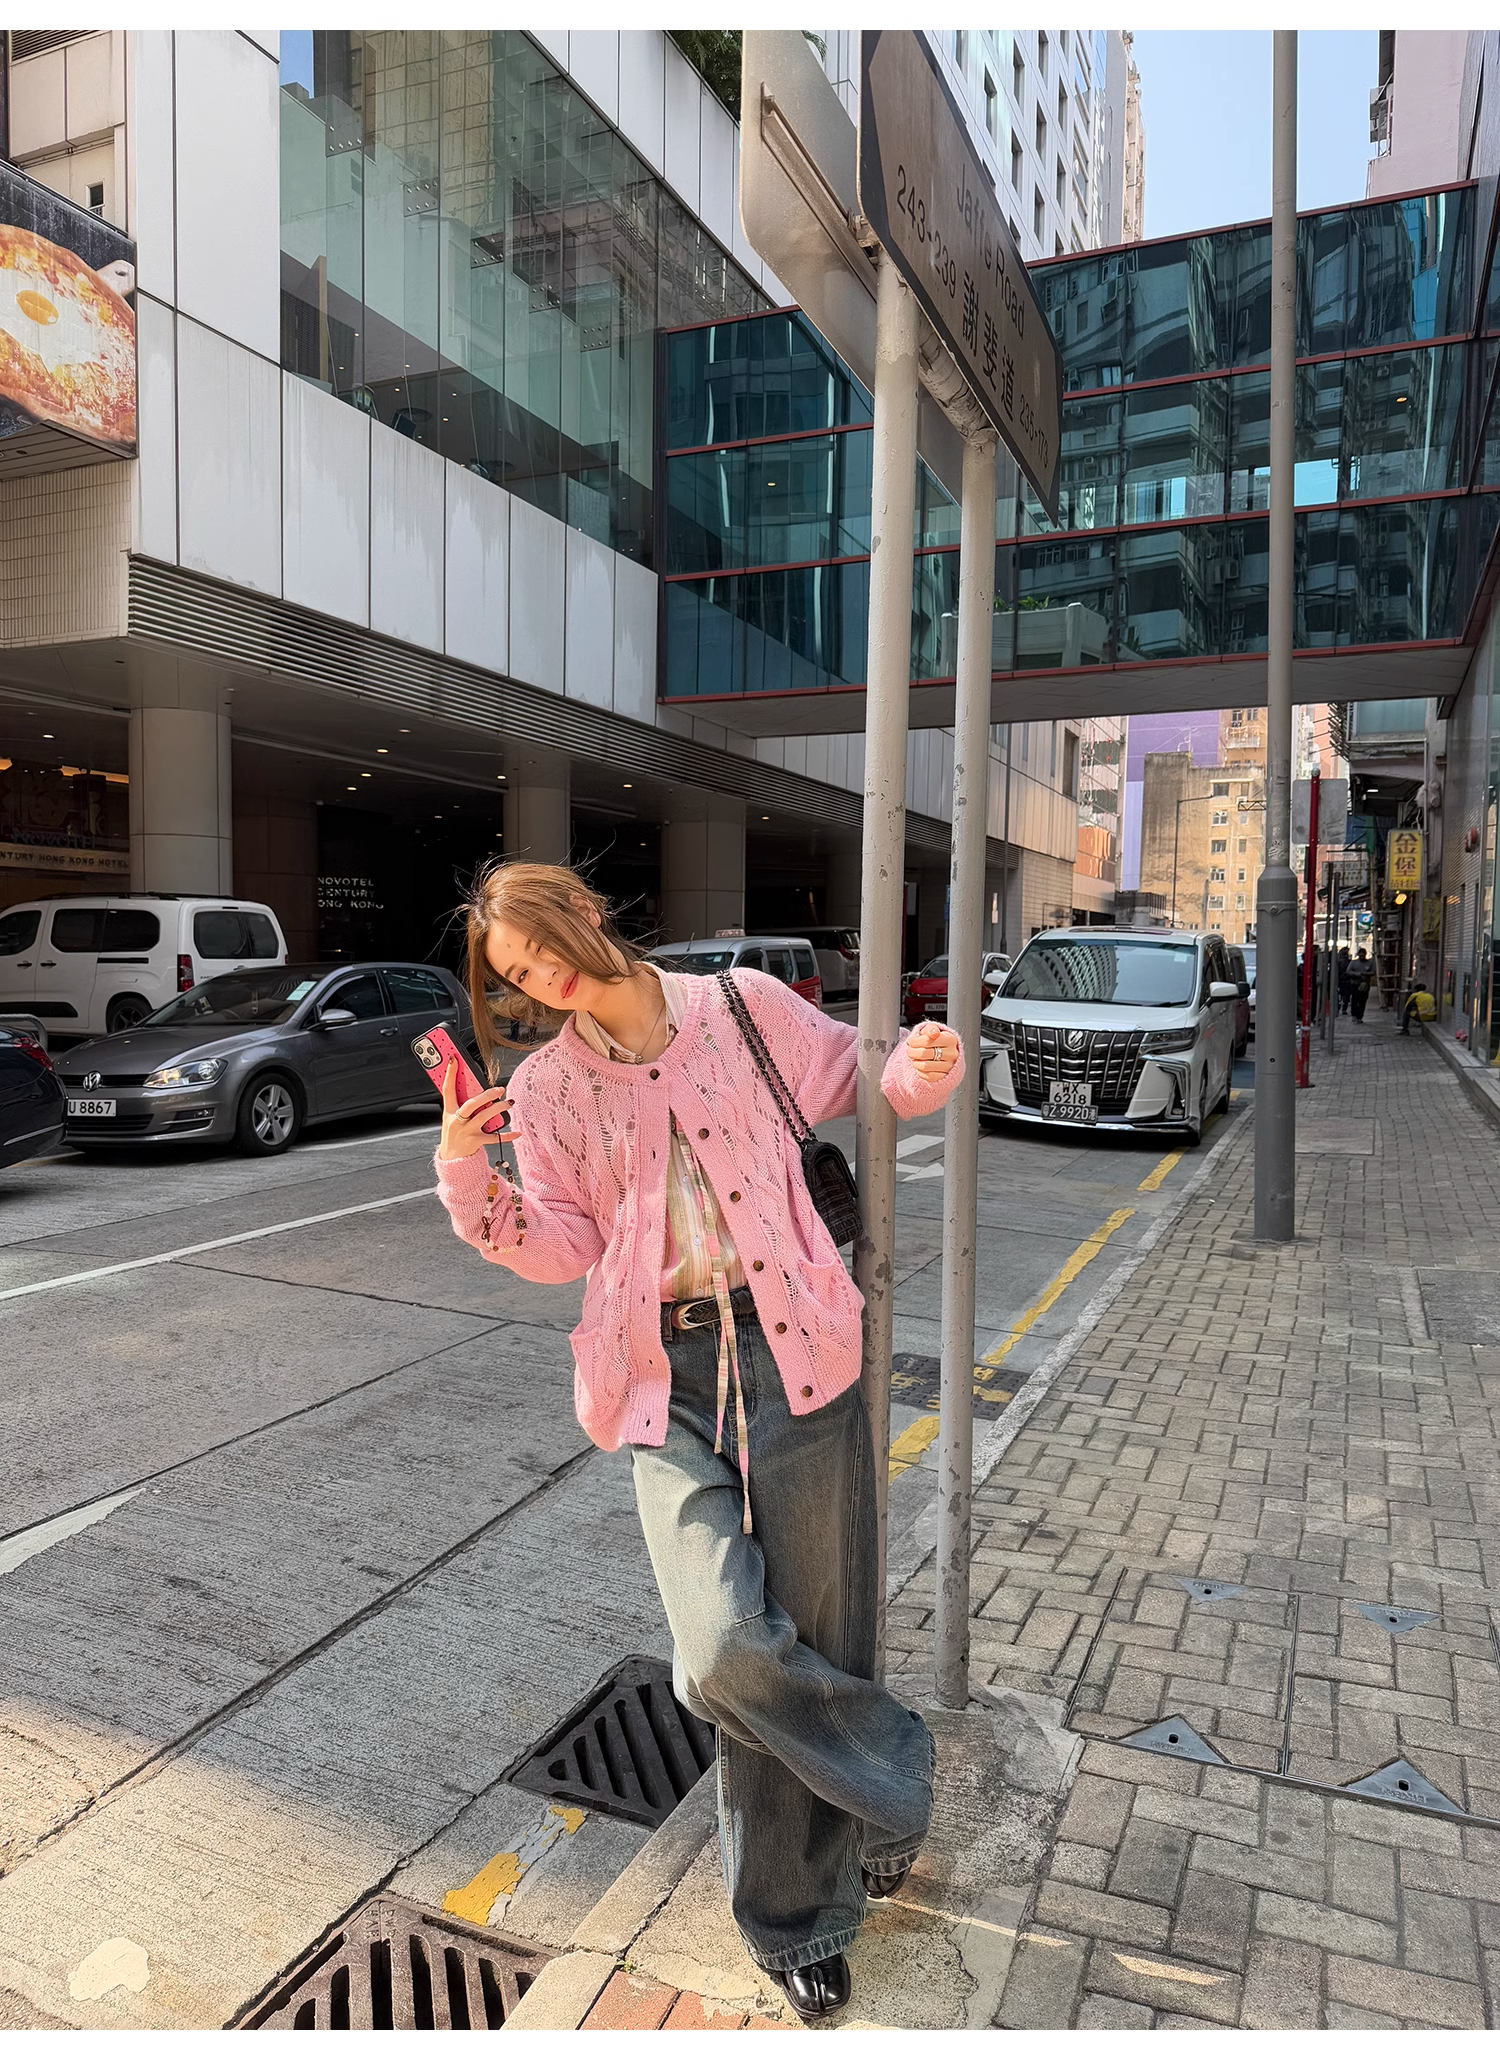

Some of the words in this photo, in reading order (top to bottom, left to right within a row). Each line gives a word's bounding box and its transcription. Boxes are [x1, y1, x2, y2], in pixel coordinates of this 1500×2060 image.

[956, 162, 992, 271] Jaffe
[995, 243, 1025, 341] Road
[896, 164, 957, 299] 243-239
[962, 269, 1015, 423] 謝斐道
[1019, 394, 1049, 469] 235-173
[39, 854, 66, 863] HONG
[69, 857, 95, 866] KONG
[98, 859, 129, 868] HOTEL
[1394, 832, 1419, 877] 金堡
[317, 877, 375, 887] NOVOTEL
[717, 929, 741, 937] TAXI
[1053, 1092, 1087, 1105] 6218
[79, 1101, 112, 1114] 8867
